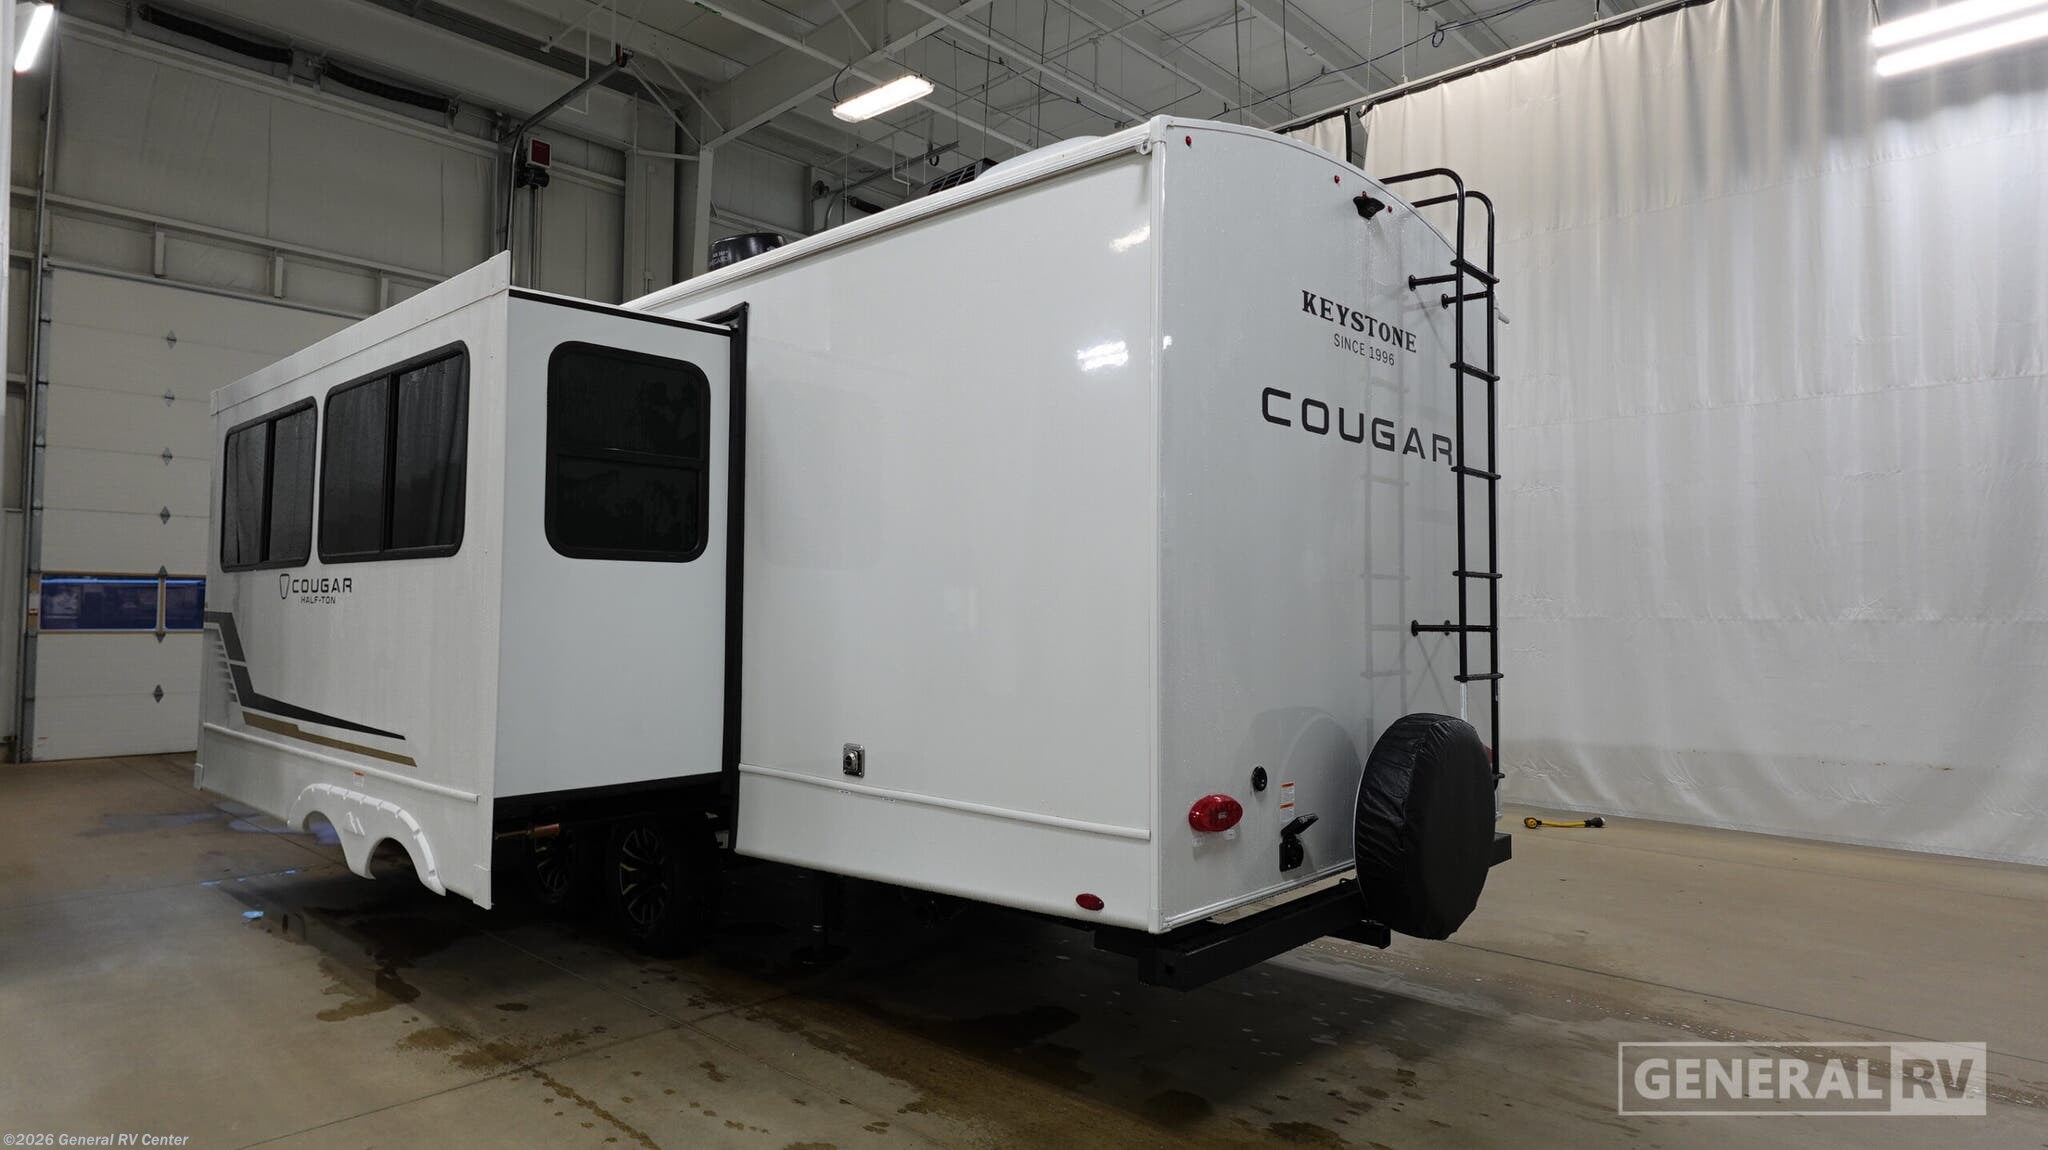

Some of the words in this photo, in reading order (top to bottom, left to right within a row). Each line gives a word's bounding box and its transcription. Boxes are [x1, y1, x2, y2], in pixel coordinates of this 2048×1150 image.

[1302, 290, 1416, 353] KEYSTONE
[1334, 333, 1366, 356] SINCE
[1369, 346, 1395, 366] 1996
[1262, 387, 1453, 466] COUGAR
[292, 577, 352, 593] COUGAR
[301, 596, 336, 604] HALF-TON
